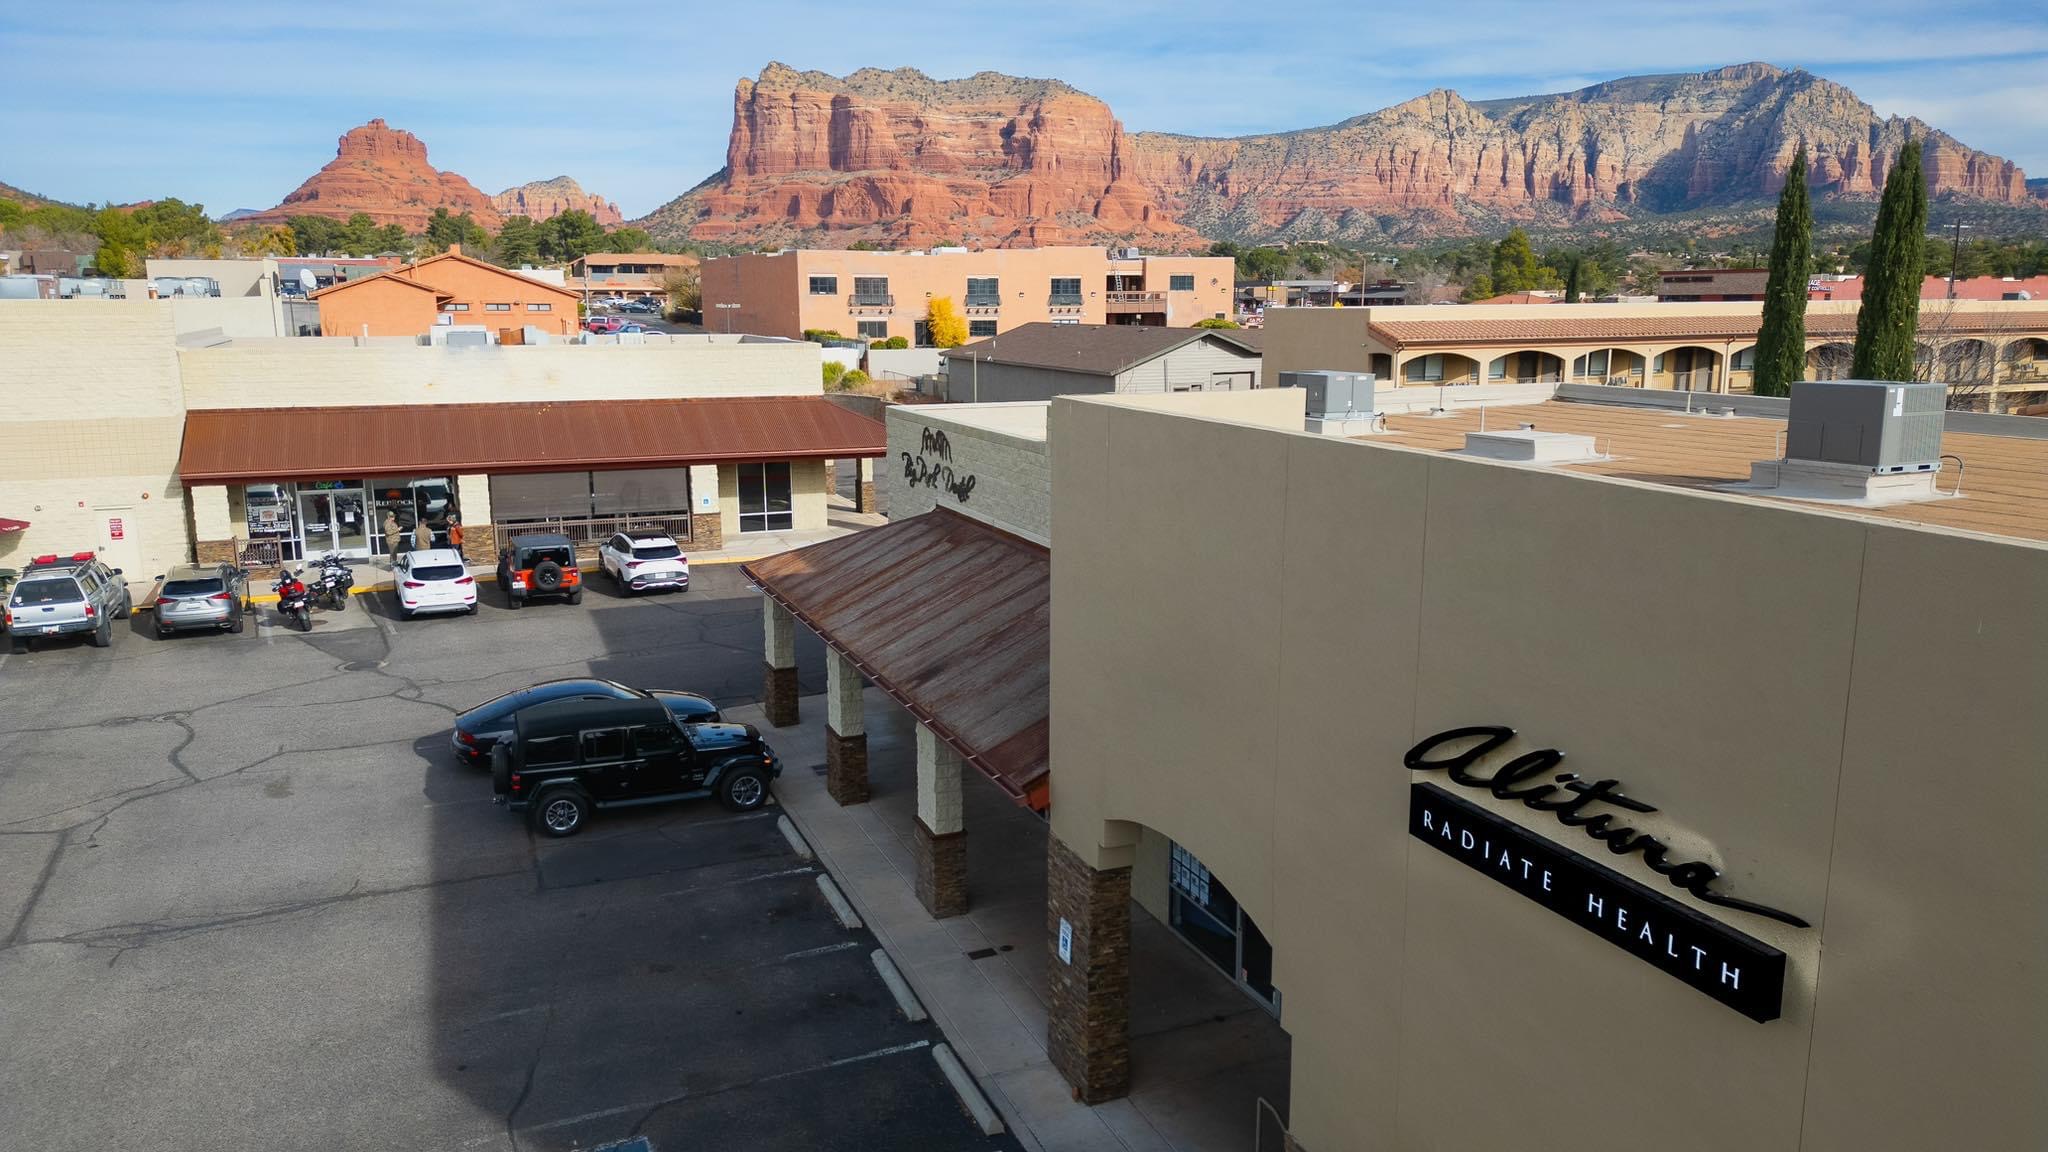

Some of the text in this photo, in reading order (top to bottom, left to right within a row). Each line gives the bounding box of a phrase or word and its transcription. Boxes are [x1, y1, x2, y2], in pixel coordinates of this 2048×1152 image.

[1404, 726, 1811, 928] Alitura
[1423, 809, 1741, 991] RADIATE HEALTH
